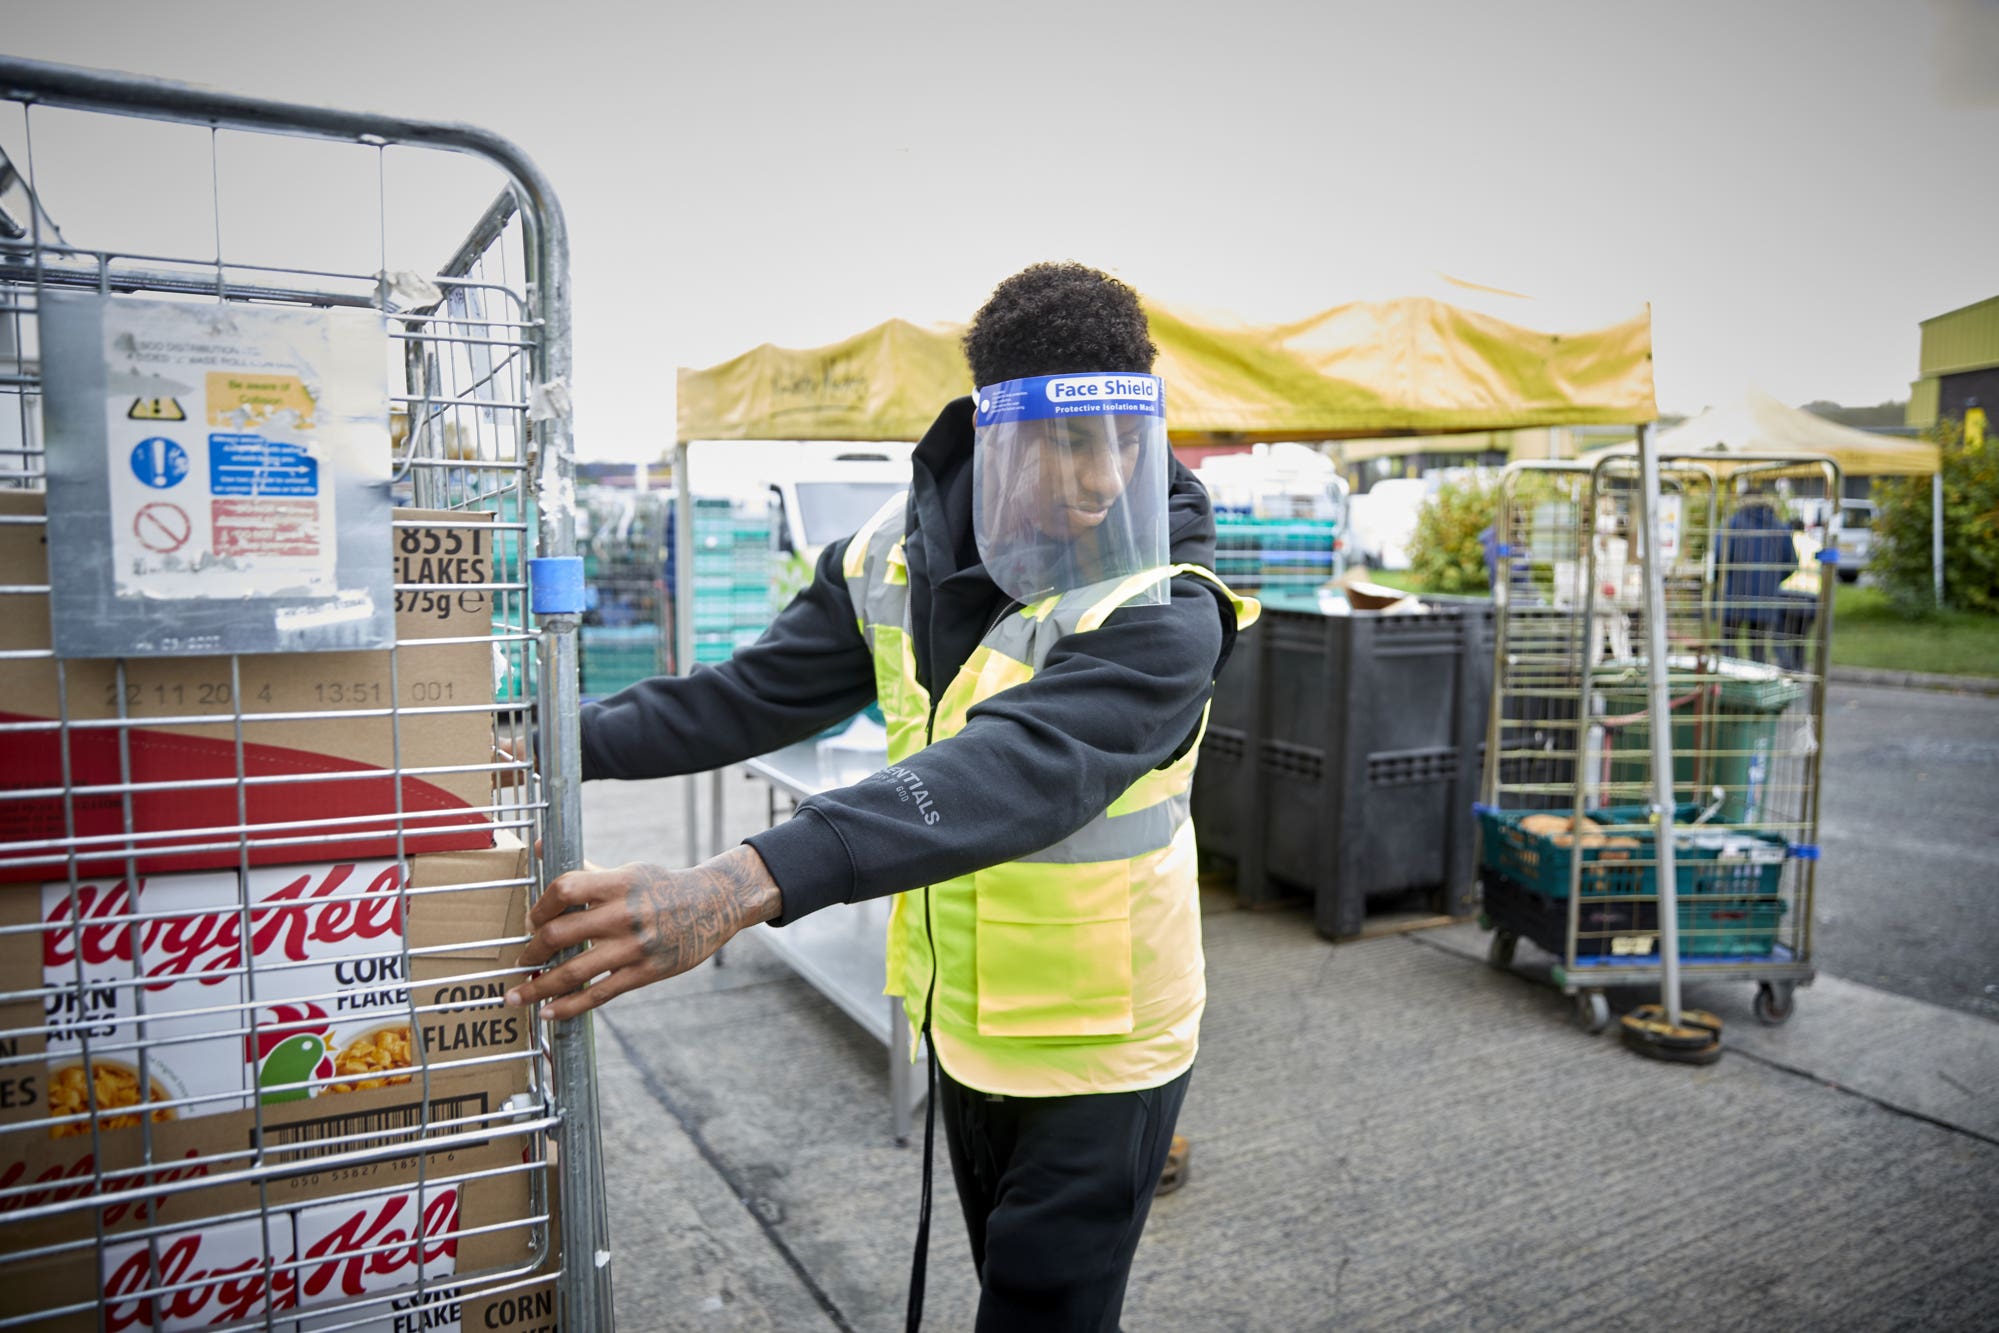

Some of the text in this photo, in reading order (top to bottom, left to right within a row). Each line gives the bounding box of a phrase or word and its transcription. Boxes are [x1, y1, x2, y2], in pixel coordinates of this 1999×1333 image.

[247, 382, 277, 391] aware
[1055, 382, 1098, 398] Face
[1105, 379, 1153, 397] Shield
[1055, 403, 1101, 414] Protective
[1103, 402, 1138, 412] Isolation
[257, 683, 273, 703] 4
[314, 683, 381, 703] 13:51
[335, 955, 405, 985] COR
[434, 982, 505, 1014] CORN
[423, 1017, 518, 1053] FLAKES
[290, 1175, 320, 1189] 050
[332, 1164, 379, 1182] 53827
[484, 1289, 552, 1330] CORN
